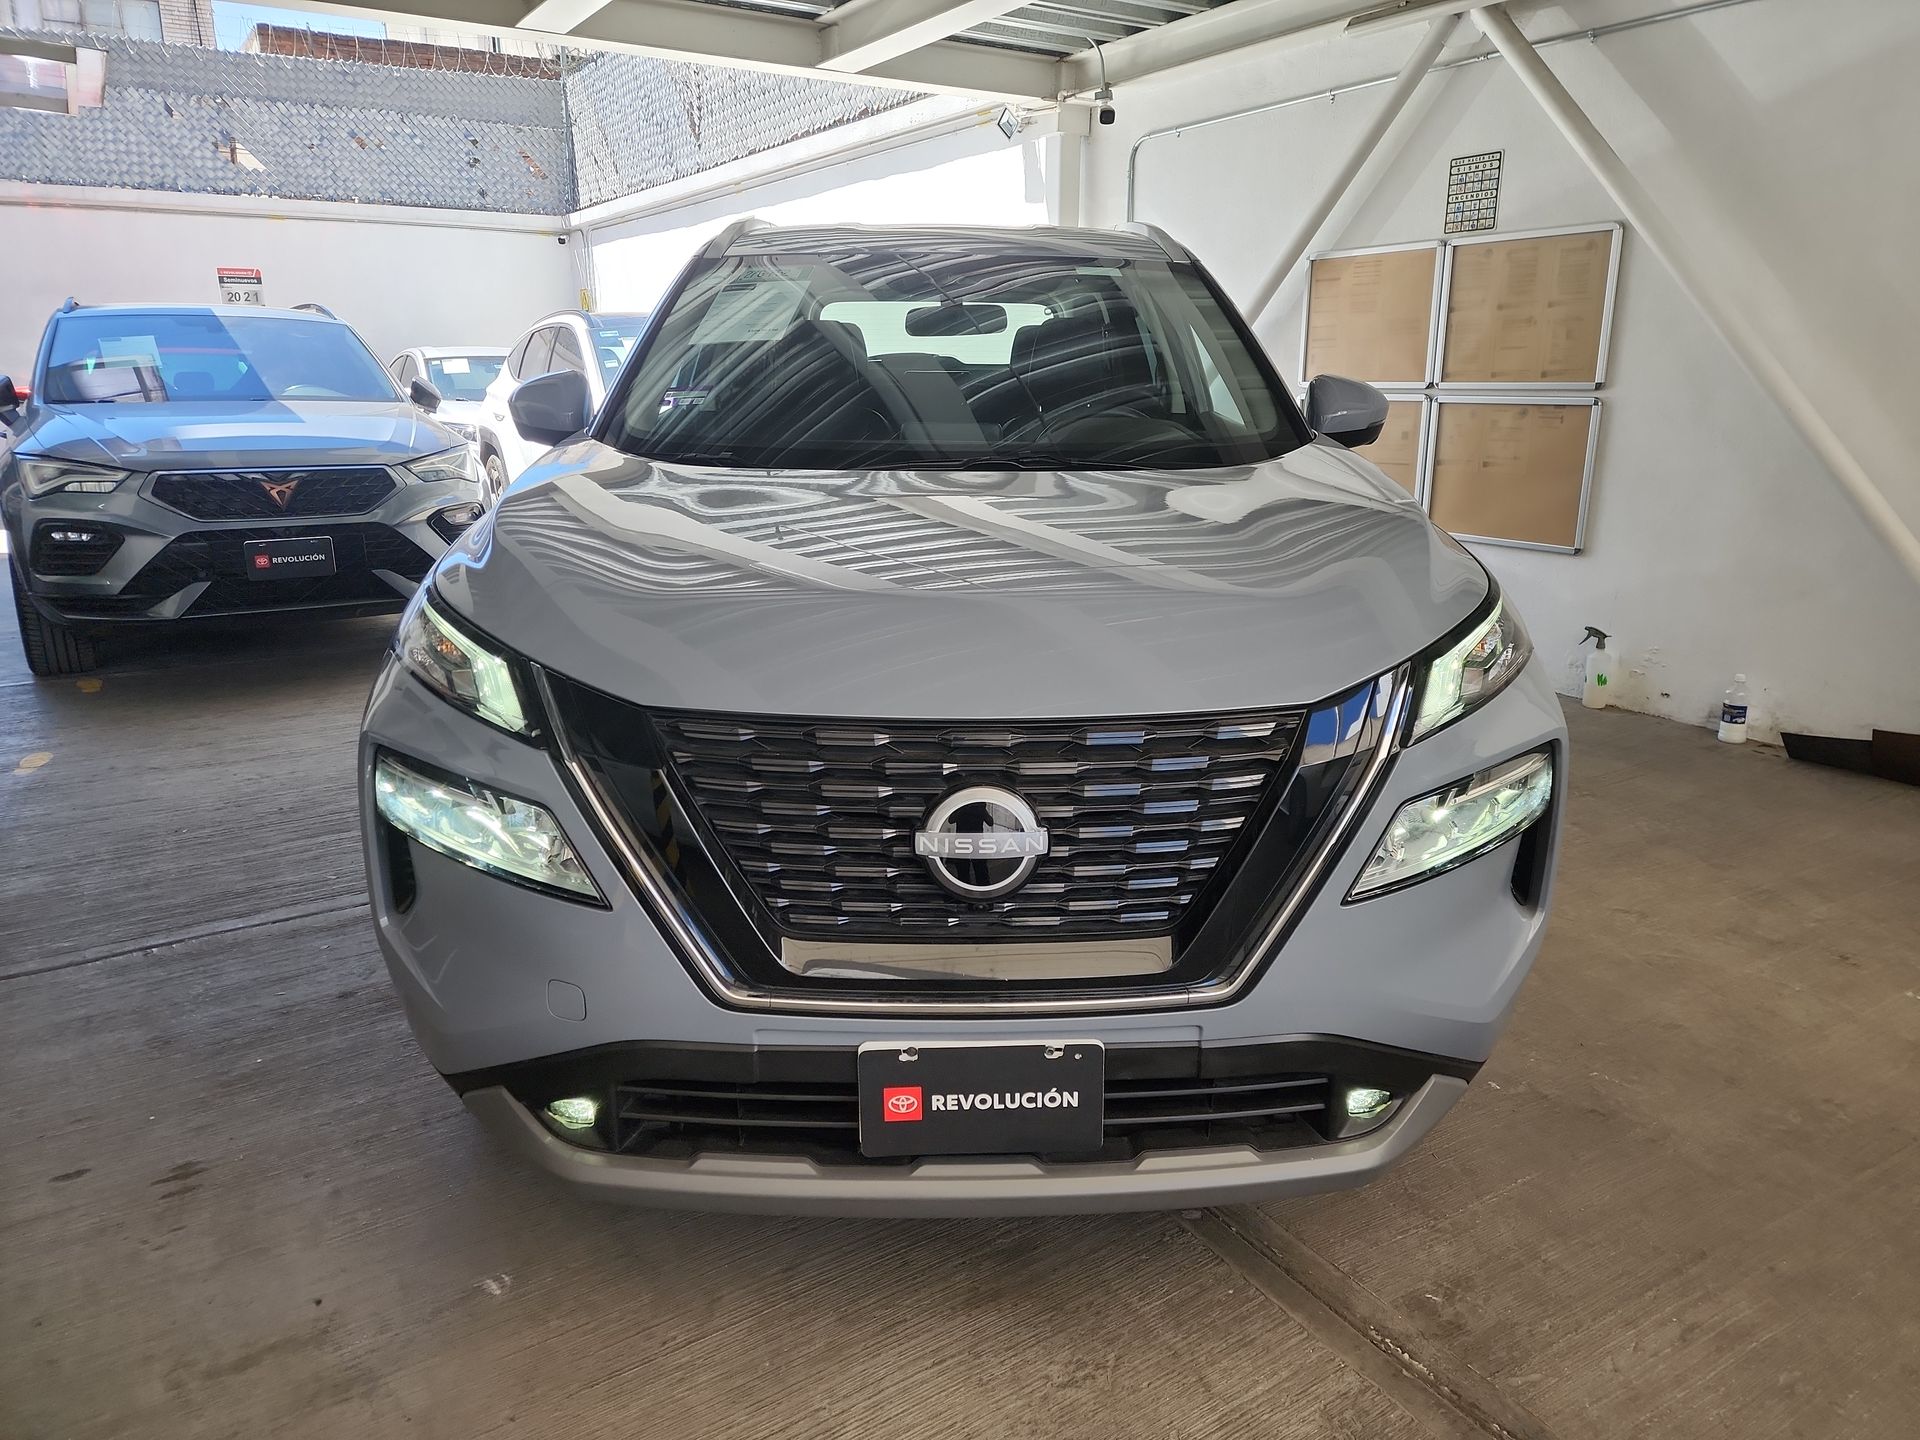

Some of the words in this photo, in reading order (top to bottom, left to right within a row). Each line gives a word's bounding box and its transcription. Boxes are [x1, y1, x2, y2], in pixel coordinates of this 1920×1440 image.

[1457, 162, 1494, 172] SISMOS
[1451, 191, 1494, 201] INCENDIOS
[272, 553, 325, 564] REVOLUCIÓN
[919, 836, 1044, 854] NISSAN
[931, 1088, 1079, 1111] REVOLUCIÓN
